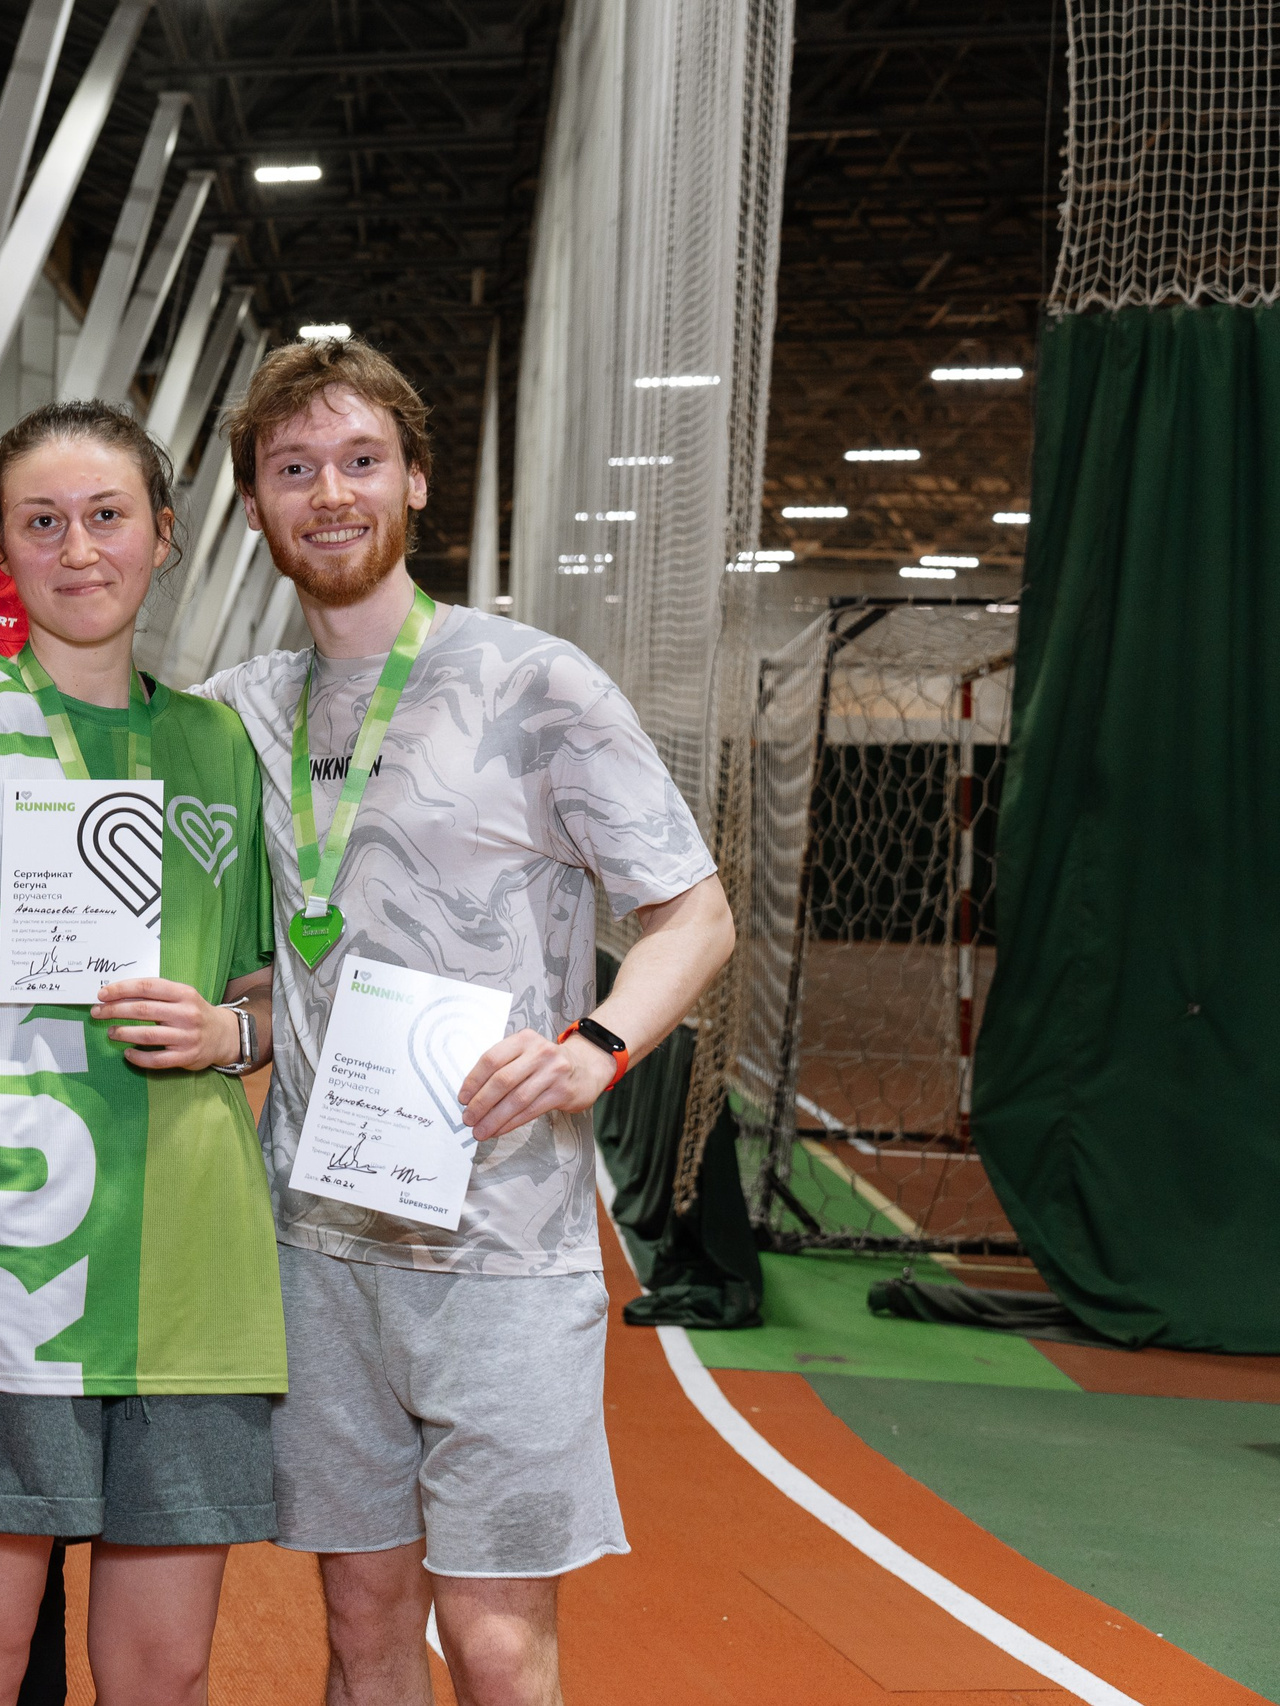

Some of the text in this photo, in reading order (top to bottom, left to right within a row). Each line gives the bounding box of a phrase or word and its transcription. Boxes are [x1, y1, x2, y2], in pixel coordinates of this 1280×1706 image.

[15, 791, 19, 800] I
[15, 802, 76, 812] RUNNING
[13, 869, 73, 880] Сертификат
[13, 880, 47, 891] бегуна
[13, 892, 63, 902] вручается
[353, 970, 359, 979] I
[26, 983, 61, 991] 26.10.24
[351, 981, 415, 1004] RUNNING
[334, 1052, 397, 1075] Сертификат
[331, 1065, 367, 1080] бегуна
[328, 1077, 380, 1096] вручается
[399, 1197, 449, 1215] SUPERSPORT
